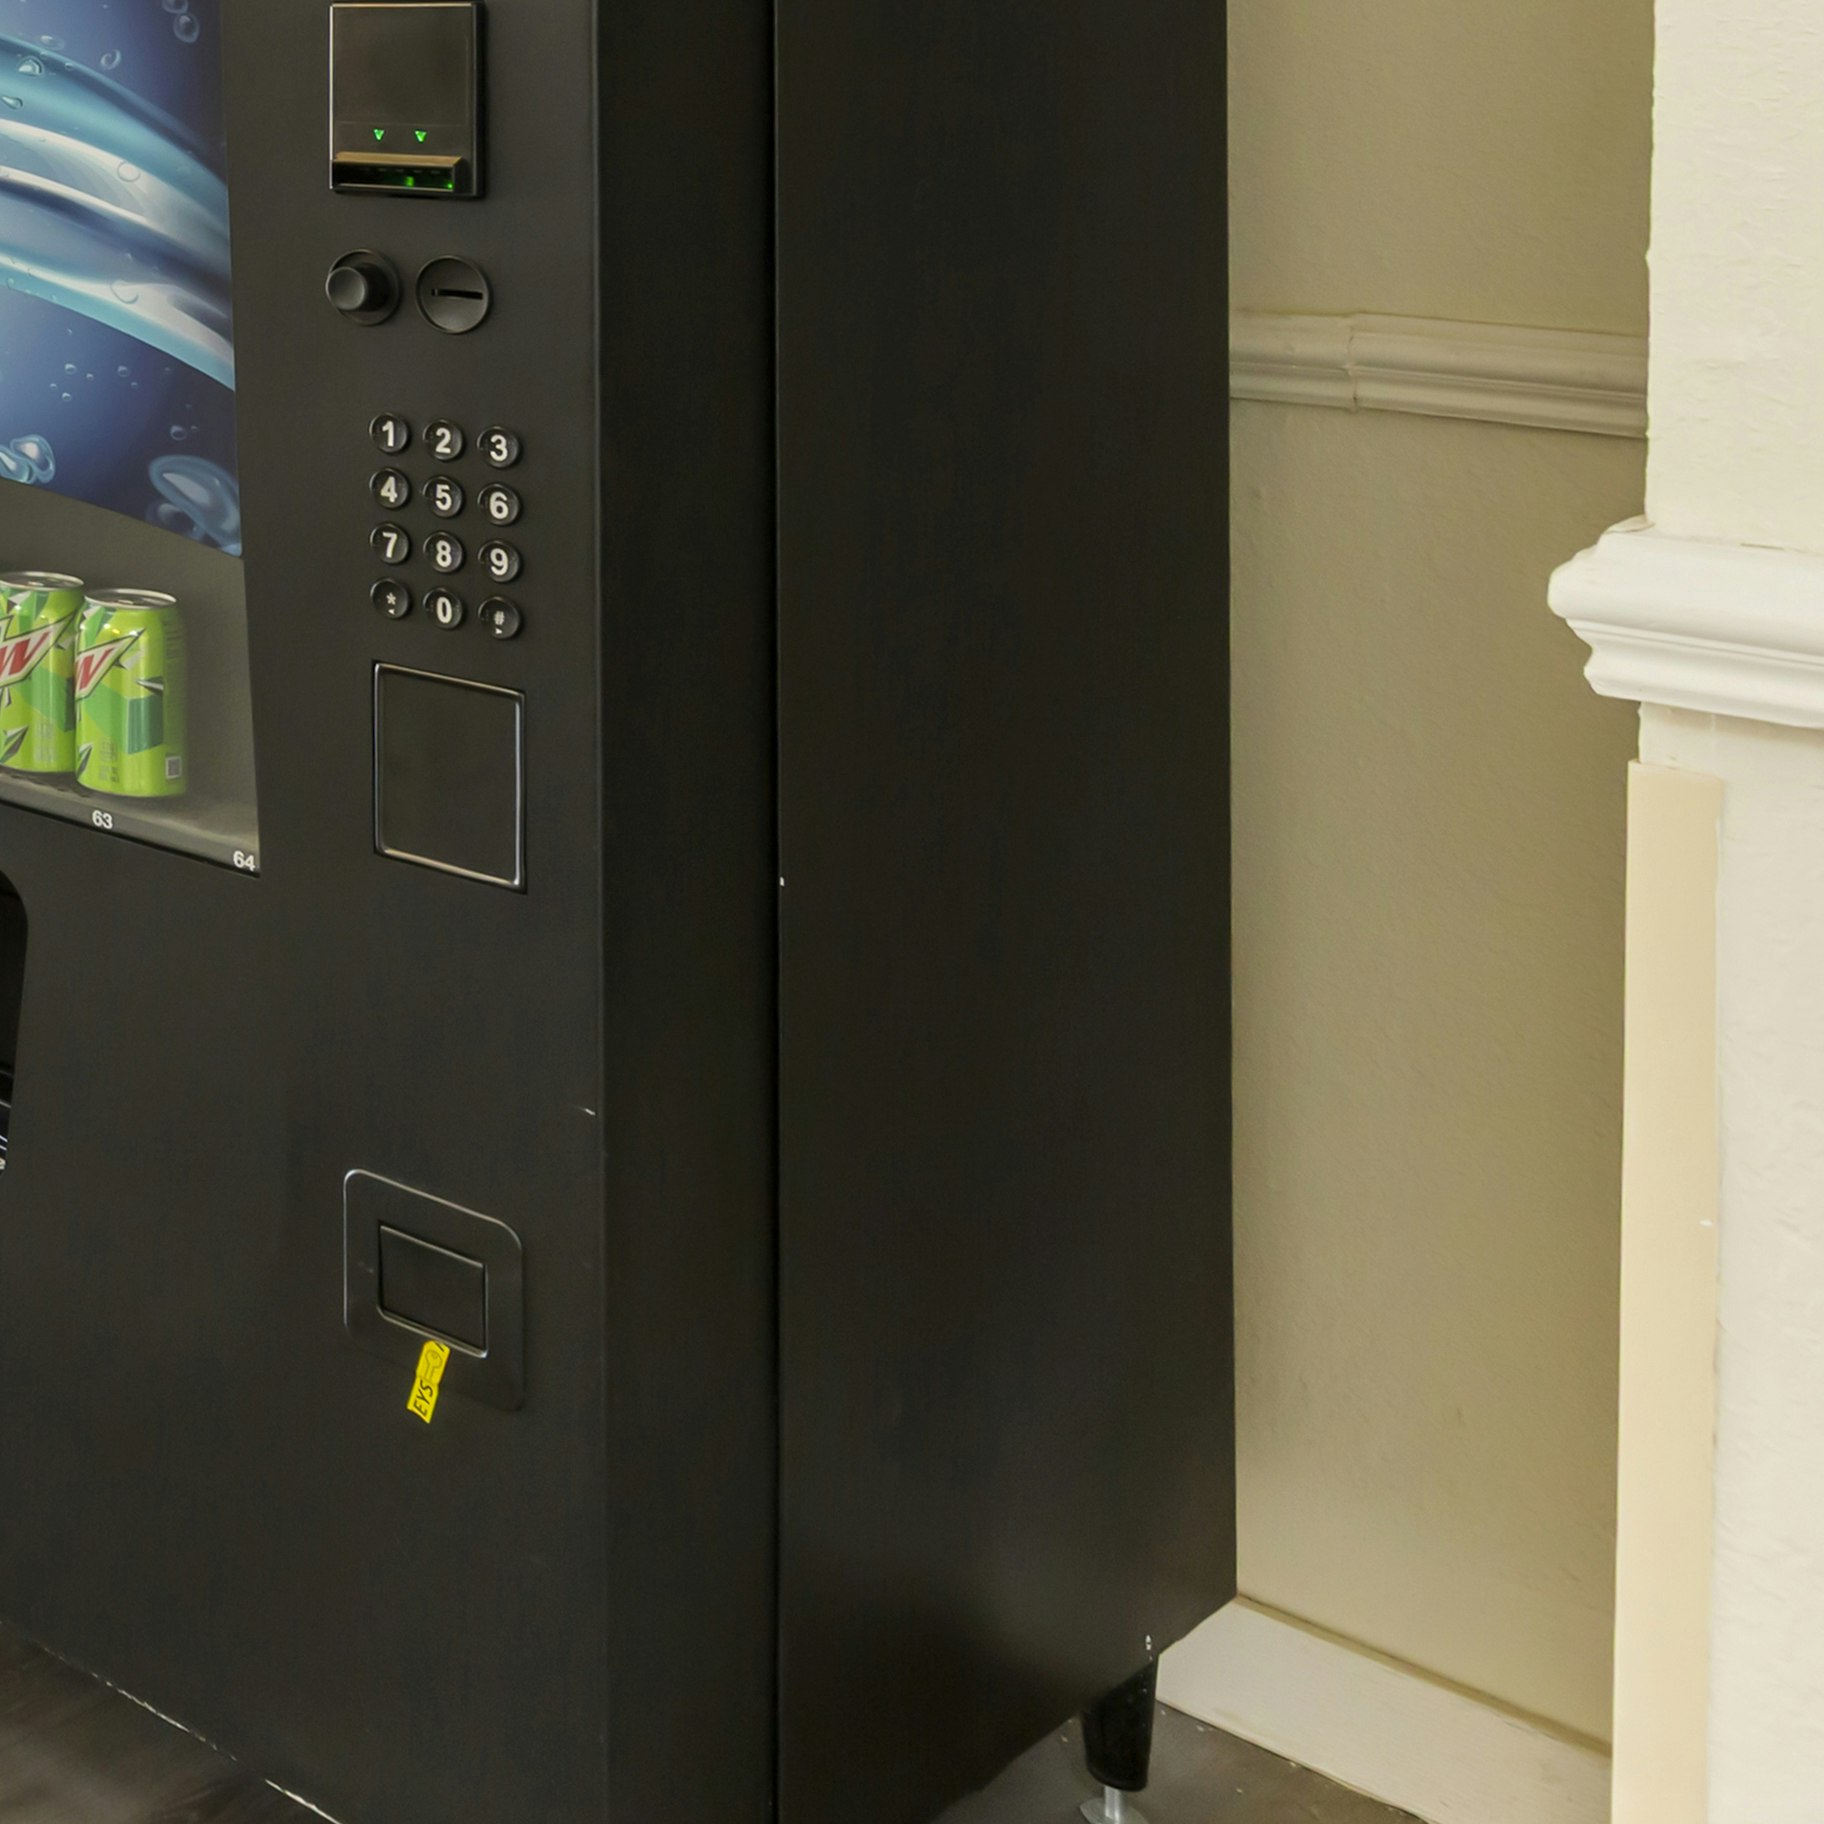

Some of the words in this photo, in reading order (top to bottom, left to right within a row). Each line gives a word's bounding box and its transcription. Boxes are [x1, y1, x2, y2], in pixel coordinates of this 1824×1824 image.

[381, 420, 395, 447] 1
[435, 427, 451, 454] 2
[489, 434, 508, 462] 3
[380, 476, 398, 503] 4
[435, 484, 452, 511] 5
[489, 491, 509, 519] 6
[382, 532, 398, 558] 7
[435, 540, 452, 568] 8
[490, 548, 509, 576] 9
[436, 596, 452, 624] 0
[91, 809, 113, 829] 63
[233, 850, 256, 872] 64
[413, 1379, 434, 1417] EYS
